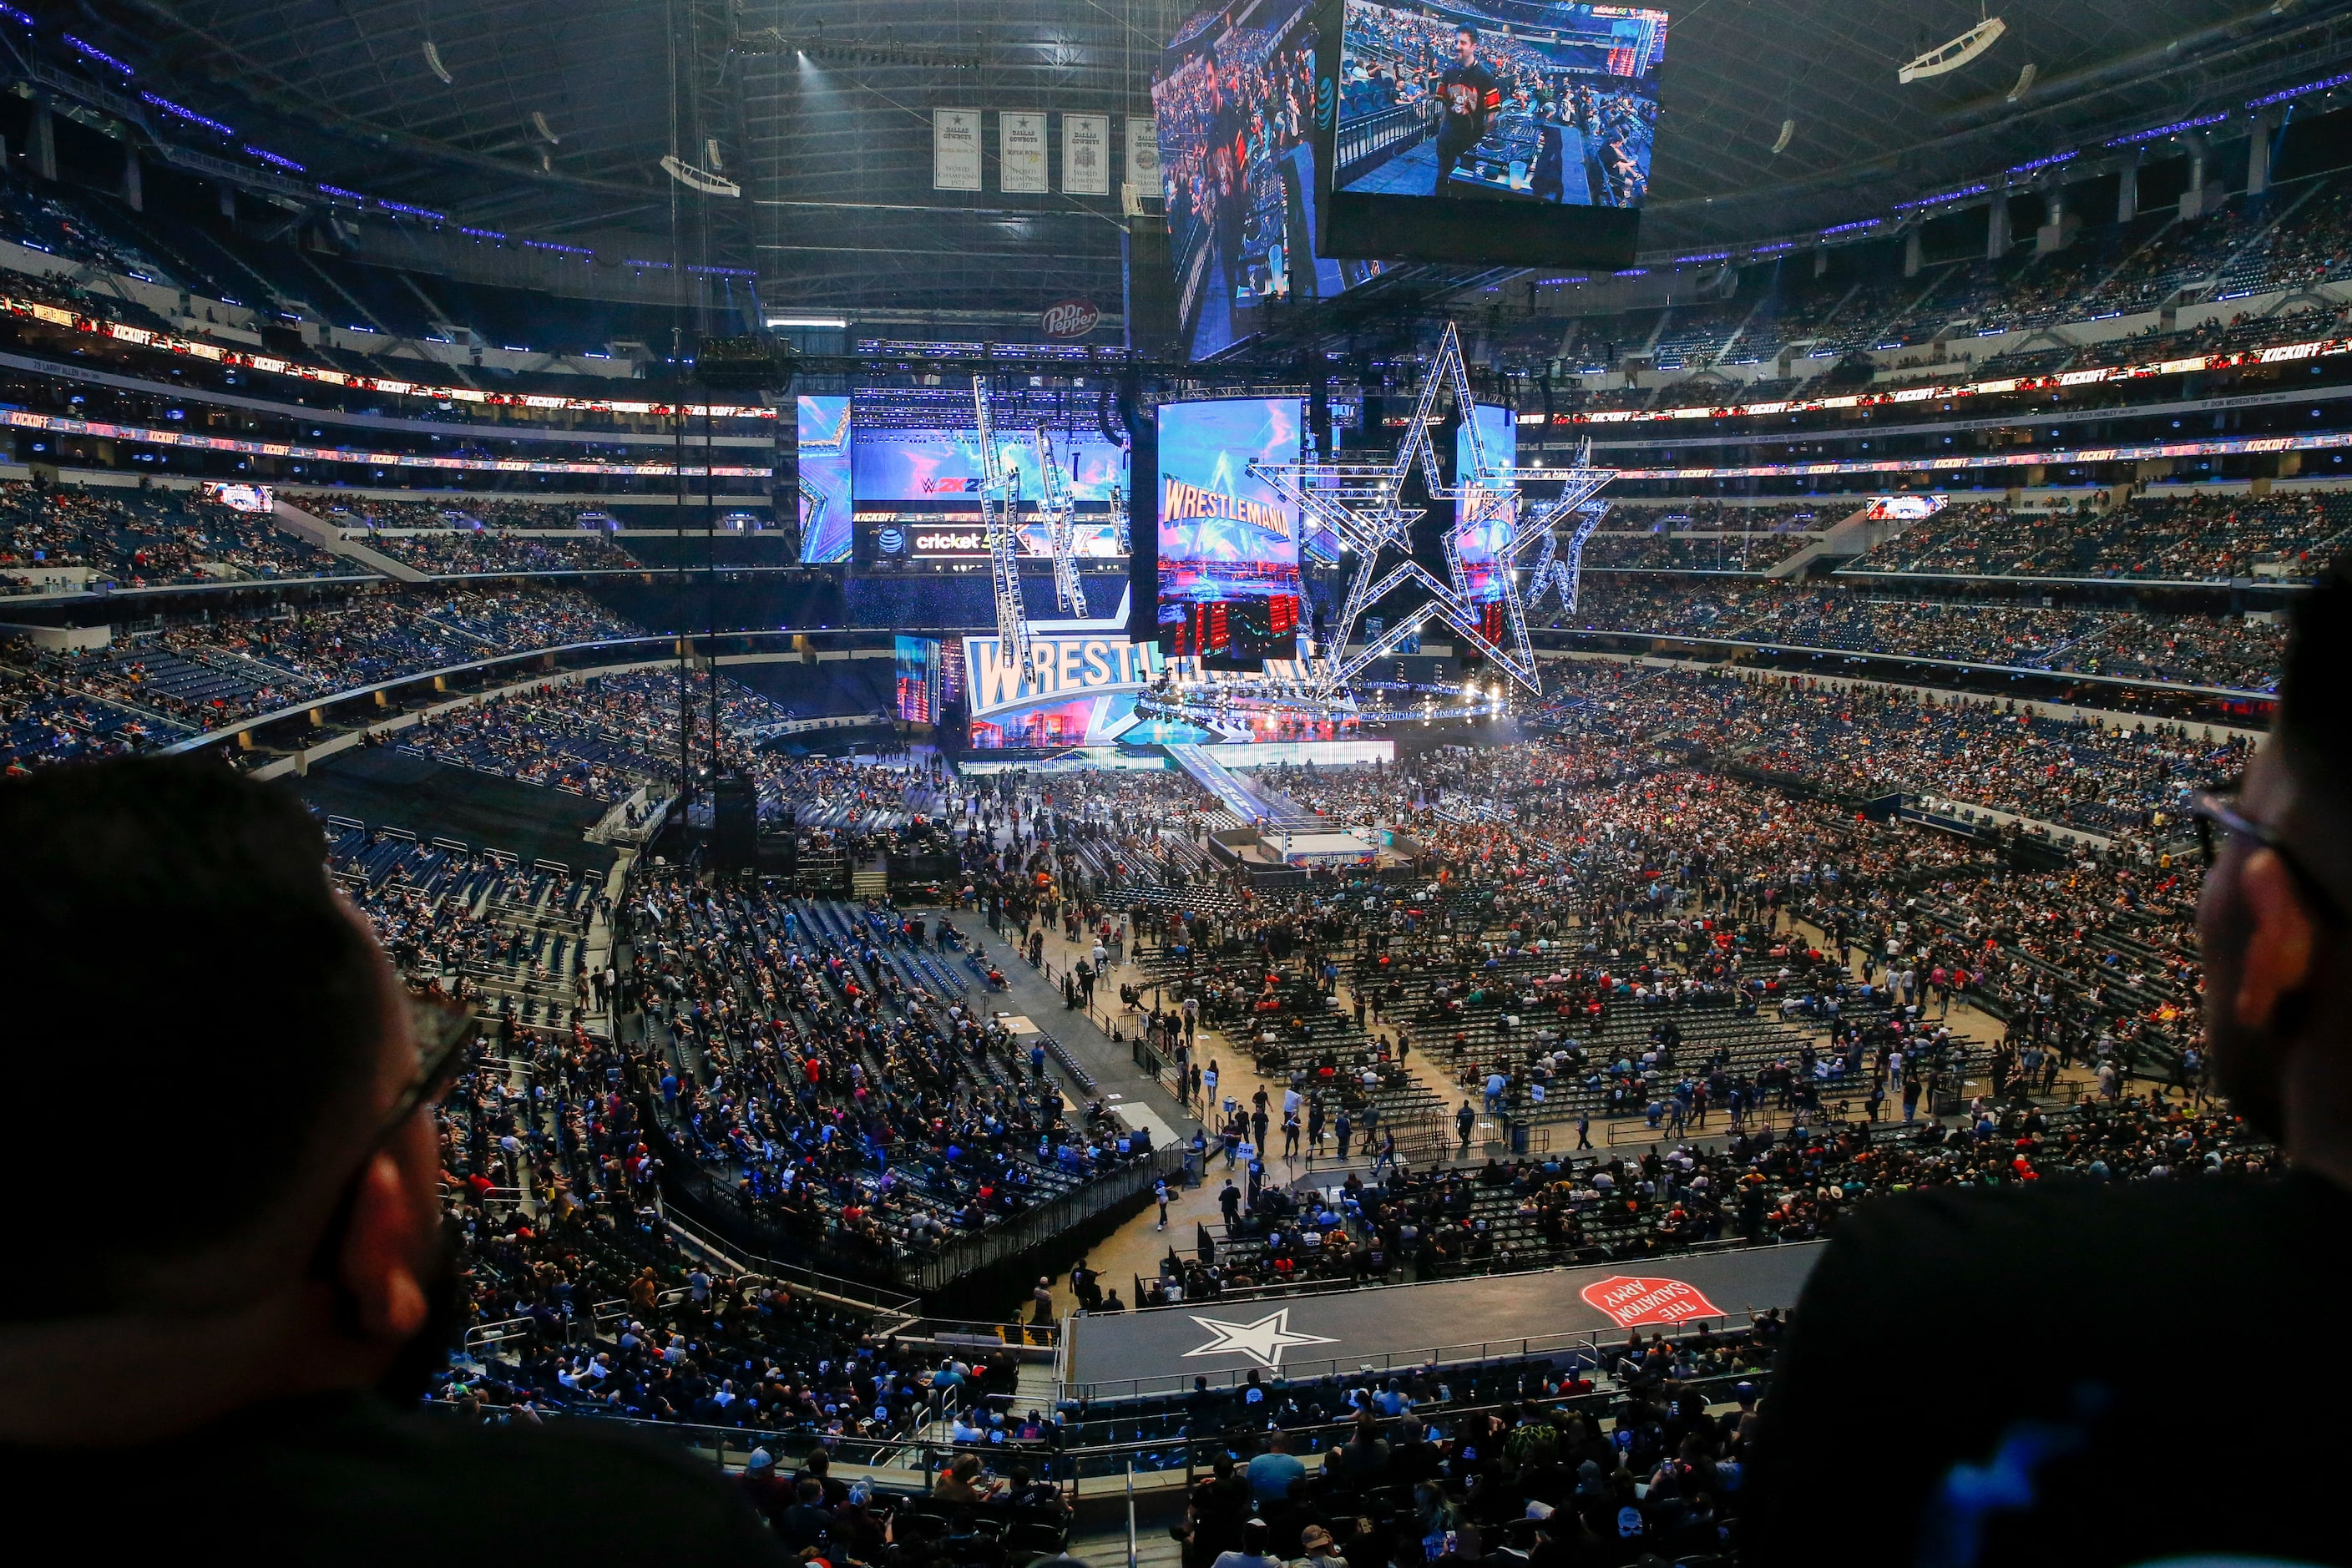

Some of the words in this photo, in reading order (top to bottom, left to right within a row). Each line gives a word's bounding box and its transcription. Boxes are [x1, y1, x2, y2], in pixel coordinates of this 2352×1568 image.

[1064, 304, 1085, 319] Dr
[1048, 306, 1096, 334] Pepper
[112, 323, 151, 345] KICKOFF
[2260, 342, 2322, 364] KICKOFF
[253, 357, 286, 373] KICKOFF
[2060, 368, 2108, 387] KICKOFF
[377, 379, 412, 394] KICKOFF
[525, 395, 567, 408] KICKOFF
[1894, 387, 1935, 402] KICKOFF
[2227, 397, 2258, 406] MEREDITH
[1748, 402, 1788, 415] KICKOFF
[11, 412, 49, 428] KICKOFF
[1590, 411, 1632, 422] KICKOFF
[148, 430, 179, 444] KICKOFF
[263, 444, 289, 456] KICKOFF
[2244, 438, 2294, 452] KICKOFF
[370, 453, 399, 465] KICKOFF
[2076, 449, 2117, 462] KICKOFF
[496, 462, 531, 471] KICKOFF
[636, 466, 672, 474] KICKOFF
[1807, 464, 1839, 474] KICKOFF
[1933, 458, 1969, 468] KICKOFF
[1679, 469, 1713, 478] KICKOFF
[1164, 478, 1291, 539] WRESTLEMANIA
[852, 513, 898, 522] KICKOFF
[916, 533, 982, 549] cricket
[1308, 854, 1358, 866] WRESTLEMANIA
[1603, 1280, 1647, 1308] ARMY
[1614, 1282, 1690, 1323] SALVATION
[1658, 1300, 1697, 1320] THE
